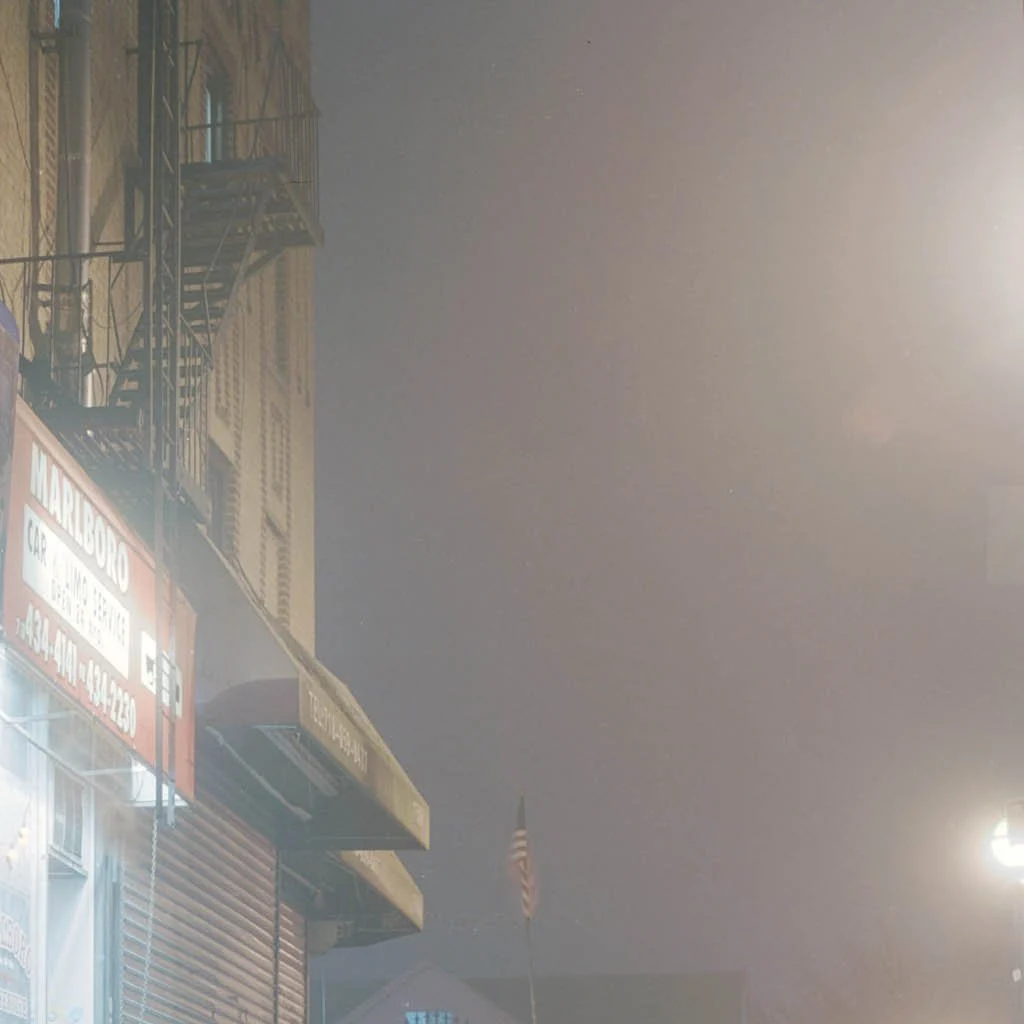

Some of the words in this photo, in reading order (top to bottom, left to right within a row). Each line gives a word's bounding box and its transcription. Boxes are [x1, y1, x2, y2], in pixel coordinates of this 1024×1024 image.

[29, 439, 130, 595] MARLBORO
[27, 519, 47, 567] CAR
[93, 588, 127, 648] SERVICE
[86, 658, 137, 738] 434-2230
